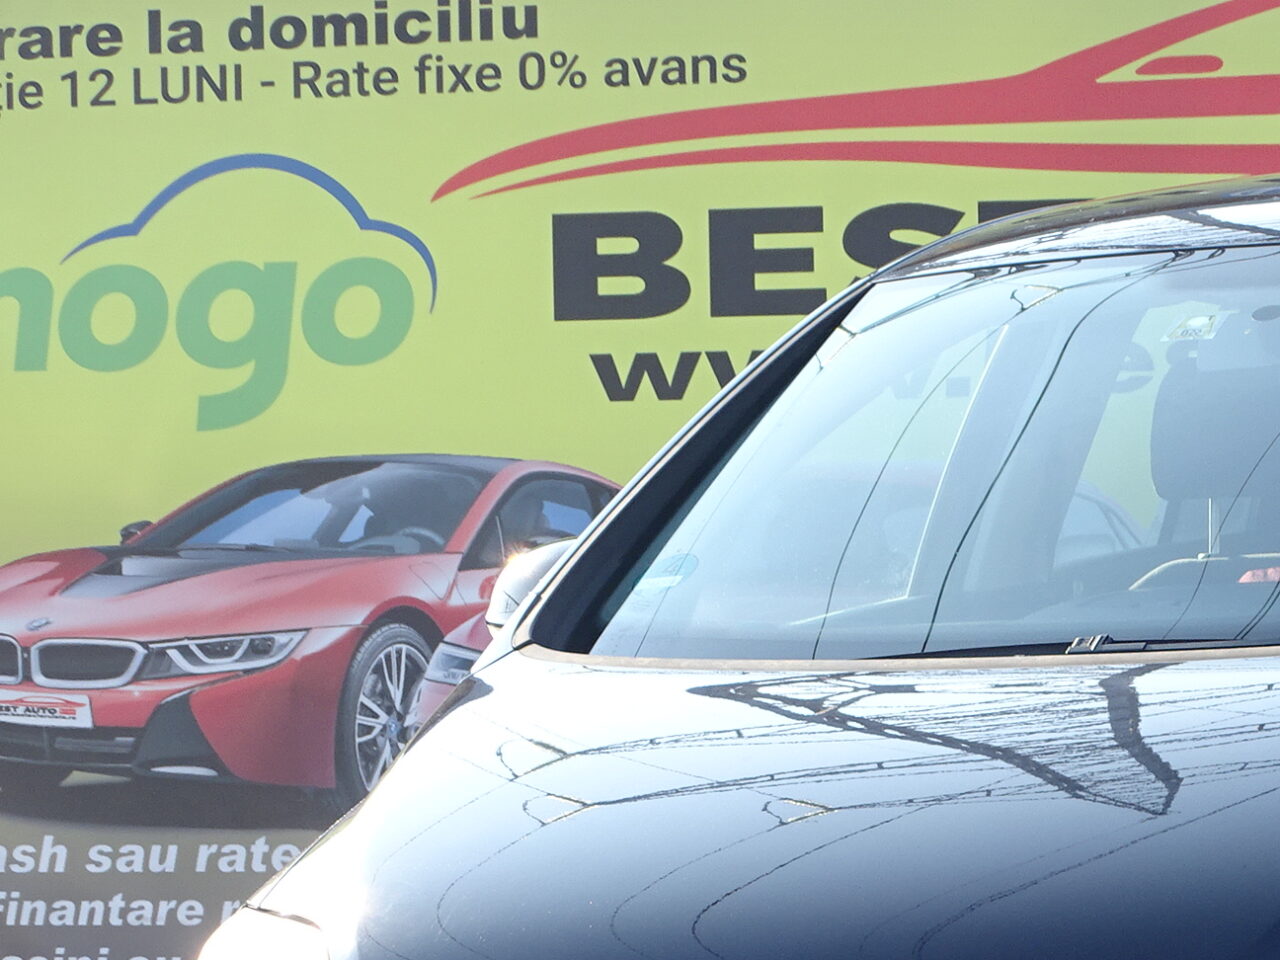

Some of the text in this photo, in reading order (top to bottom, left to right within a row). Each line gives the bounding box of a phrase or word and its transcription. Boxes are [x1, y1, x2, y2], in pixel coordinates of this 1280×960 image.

[147, 9, 204, 55] la
[228, 0, 538, 51] domiciliu
[0, 72, 44, 118] ie
[60, 69, 116, 108] 12
[133, 63, 242, 105] LUNI
[292, 60, 399, 100] Rate
[414, 54, 502, 94] fixe
[518, 50, 588, 91] 0%
[603, 53, 748, 88] avans
[0, 835, 302, 874] sh sau rate
